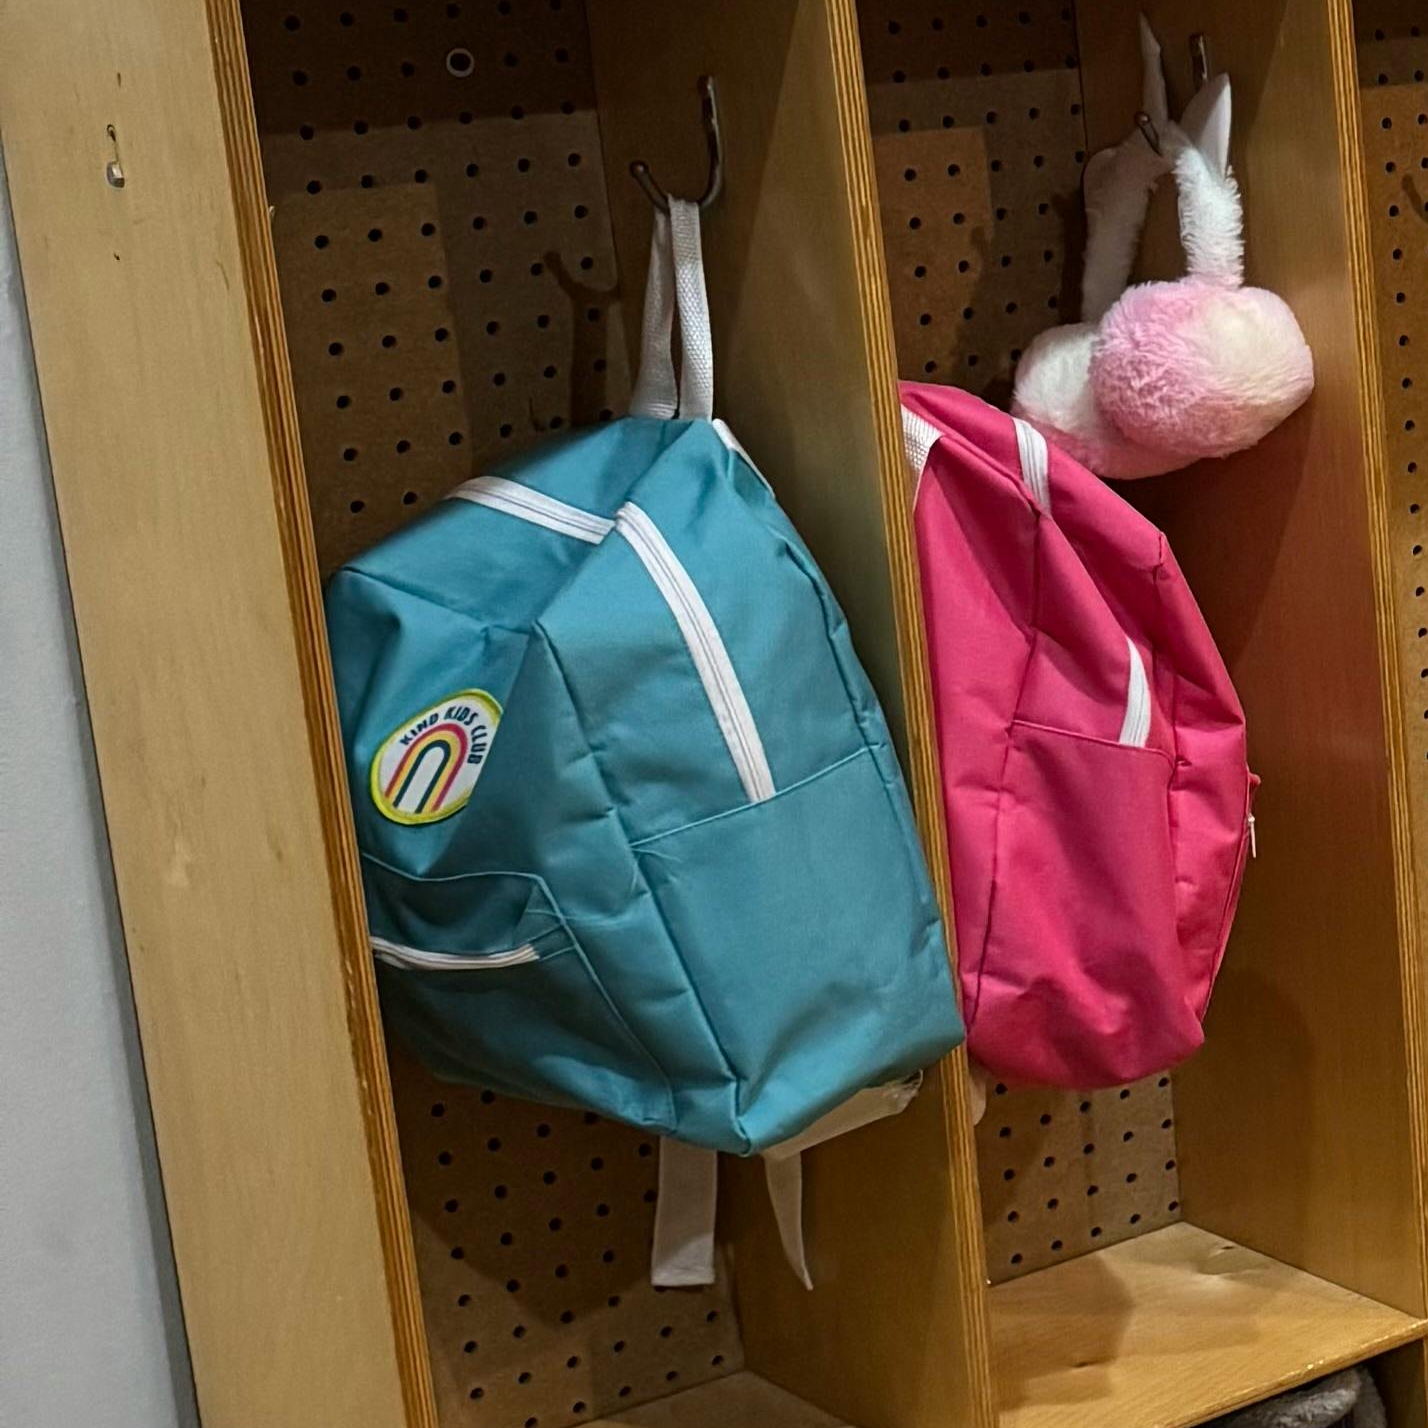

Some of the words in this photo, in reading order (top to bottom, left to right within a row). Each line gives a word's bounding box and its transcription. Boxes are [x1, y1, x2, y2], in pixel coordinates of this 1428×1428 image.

[400, 713, 439, 746] KIND
[444, 705, 479, 726] KIDS
[467, 724, 488, 765] CLUB
